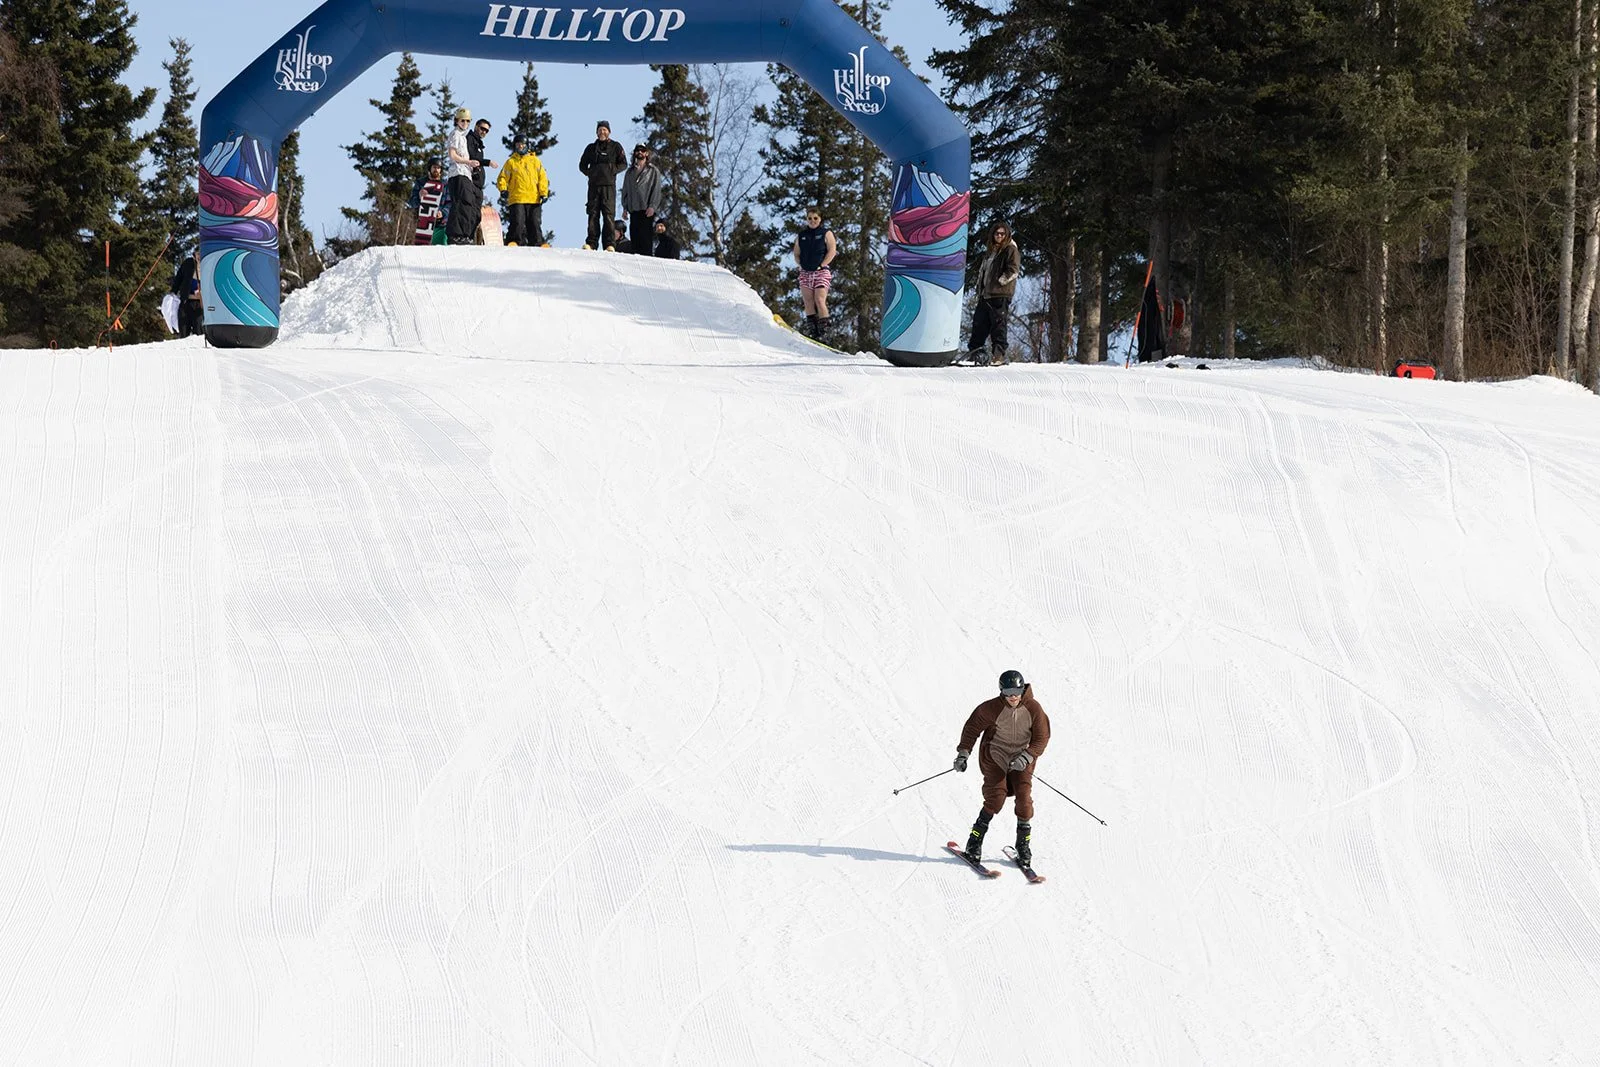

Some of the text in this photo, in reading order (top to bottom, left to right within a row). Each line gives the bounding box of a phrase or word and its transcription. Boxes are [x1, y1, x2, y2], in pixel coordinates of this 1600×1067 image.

[479, 4, 686, 42] HILLTOP
[275, 25, 333, 72] Hilltop
[282, 60, 311, 80] Ski
[833, 46, 891, 94] Hilltop
[278, 76, 319, 92] Area
[841, 82, 871, 101] Ski
[844, 97, 880, 113] Area
